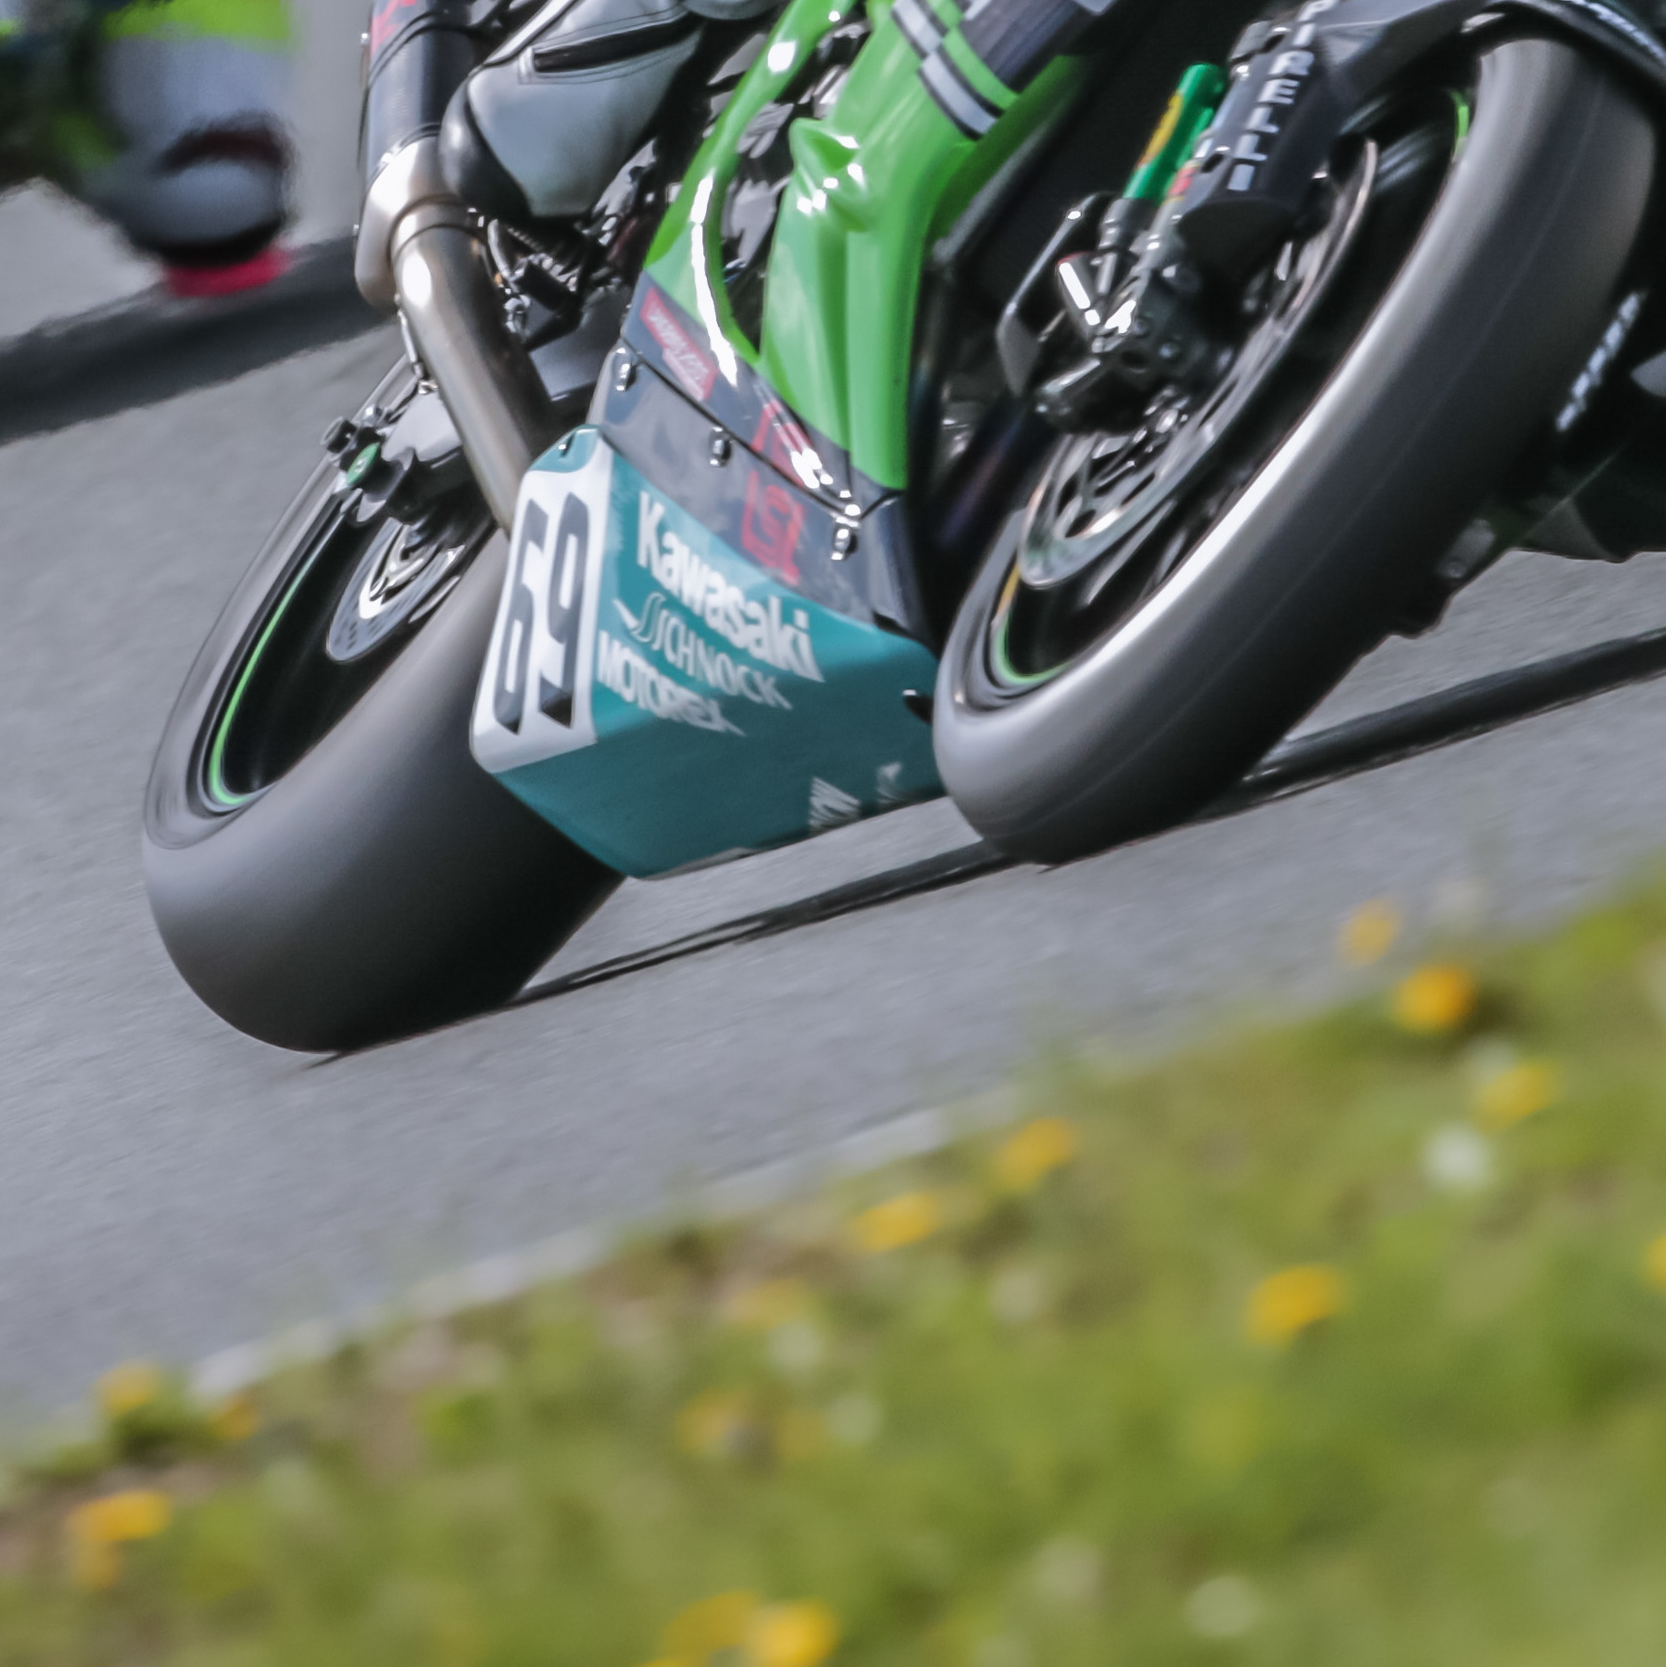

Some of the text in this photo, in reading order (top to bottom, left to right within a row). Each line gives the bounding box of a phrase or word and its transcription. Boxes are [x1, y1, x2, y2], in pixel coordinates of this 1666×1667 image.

[493, 491, 591, 735] 69
[597, 630, 748, 736] MOTOREX
[636, 490, 827, 683] Kawasaki
